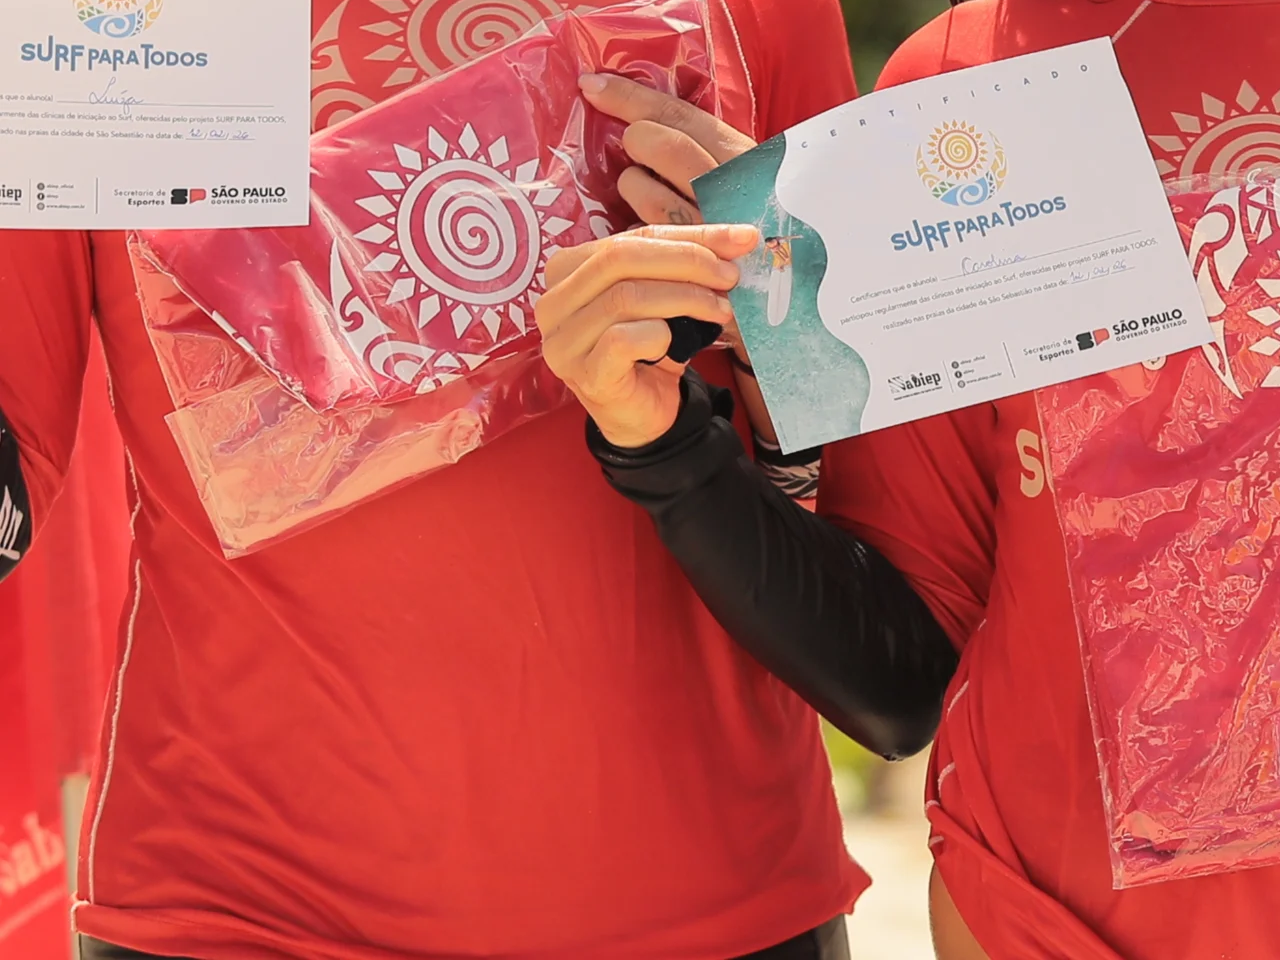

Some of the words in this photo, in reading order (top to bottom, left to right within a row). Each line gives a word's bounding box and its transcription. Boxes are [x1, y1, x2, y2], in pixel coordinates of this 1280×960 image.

[20, 35, 85, 72] SURF
[88, 48, 140, 72] PARA
[140, 43, 209, 70] TODOS
[27, 110, 40, 119] das
[66, 111, 76, 120] de
[135, 114, 171, 123] oferecidas
[172, 114, 188, 123] pelo
[189, 115, 215, 125] projeto
[216, 116, 235, 124] SURF
[236, 116, 256, 124] PARA
[800, 63, 1089, 150] CERTIFICADO
[28, 128, 49, 137] praias
[50, 128, 60, 136] da
[60, 129, 84, 138] cidade
[85, 129, 95, 138] de
[96, 129, 109, 138] São
[111, 129, 144, 139] Sebastião
[146, 131, 155, 139] na
[156, 131, 172, 139] data
[113, 188, 154, 197] Secretaria
[156, 188, 166, 197] de
[127, 198, 165, 208] Esportes
[211, 185, 239, 199] SÃO
[243, 187, 286, 198] PAULO
[890, 219, 951, 252] SURF
[953, 211, 1005, 243] PARA
[999, 196, 1067, 227] TODOS
[839, 311, 873, 325] participou
[874, 299, 917, 315] regularmente
[918, 295, 930, 303] das
[931, 289, 954, 300] clínicas
[954, 286, 964, 294] de
[964, 279, 992, 291] iniciação
[1018, 265, 1052, 278] oferecidas
[1051, 261, 1067, 271] pelo
[1067, 255, 1091, 268] projeto
[1091, 248, 1109, 260] SURF
[1110, 244, 1130, 256] PARA
[849, 288, 891, 304] Certificamos
[891, 284, 905, 293] que
[911, 275, 937, 287] aluno(a)
[882, 317, 912, 330] realizado
[924, 310, 944, 320] praias
[942, 306, 955, 315] da
[955, 300, 977, 311] cidade
[977, 296, 987, 306] de
[987, 295, 1001, 304] São
[1000, 287, 1032, 300] Sebastião
[1042, 281, 1057, 290] data
[1112, 319, 1139, 335] SÃO
[1141, 308, 1183, 328] PAULO
[1115, 329, 1149, 342] GOVERNO
[1150, 326, 1161, 334] DO
[1162, 319, 1188, 331] ESTADO
[1023, 341, 1061, 356] Secretaria
[1063, 338, 1072, 346] de
[1039, 347, 1075, 362] Esportes
